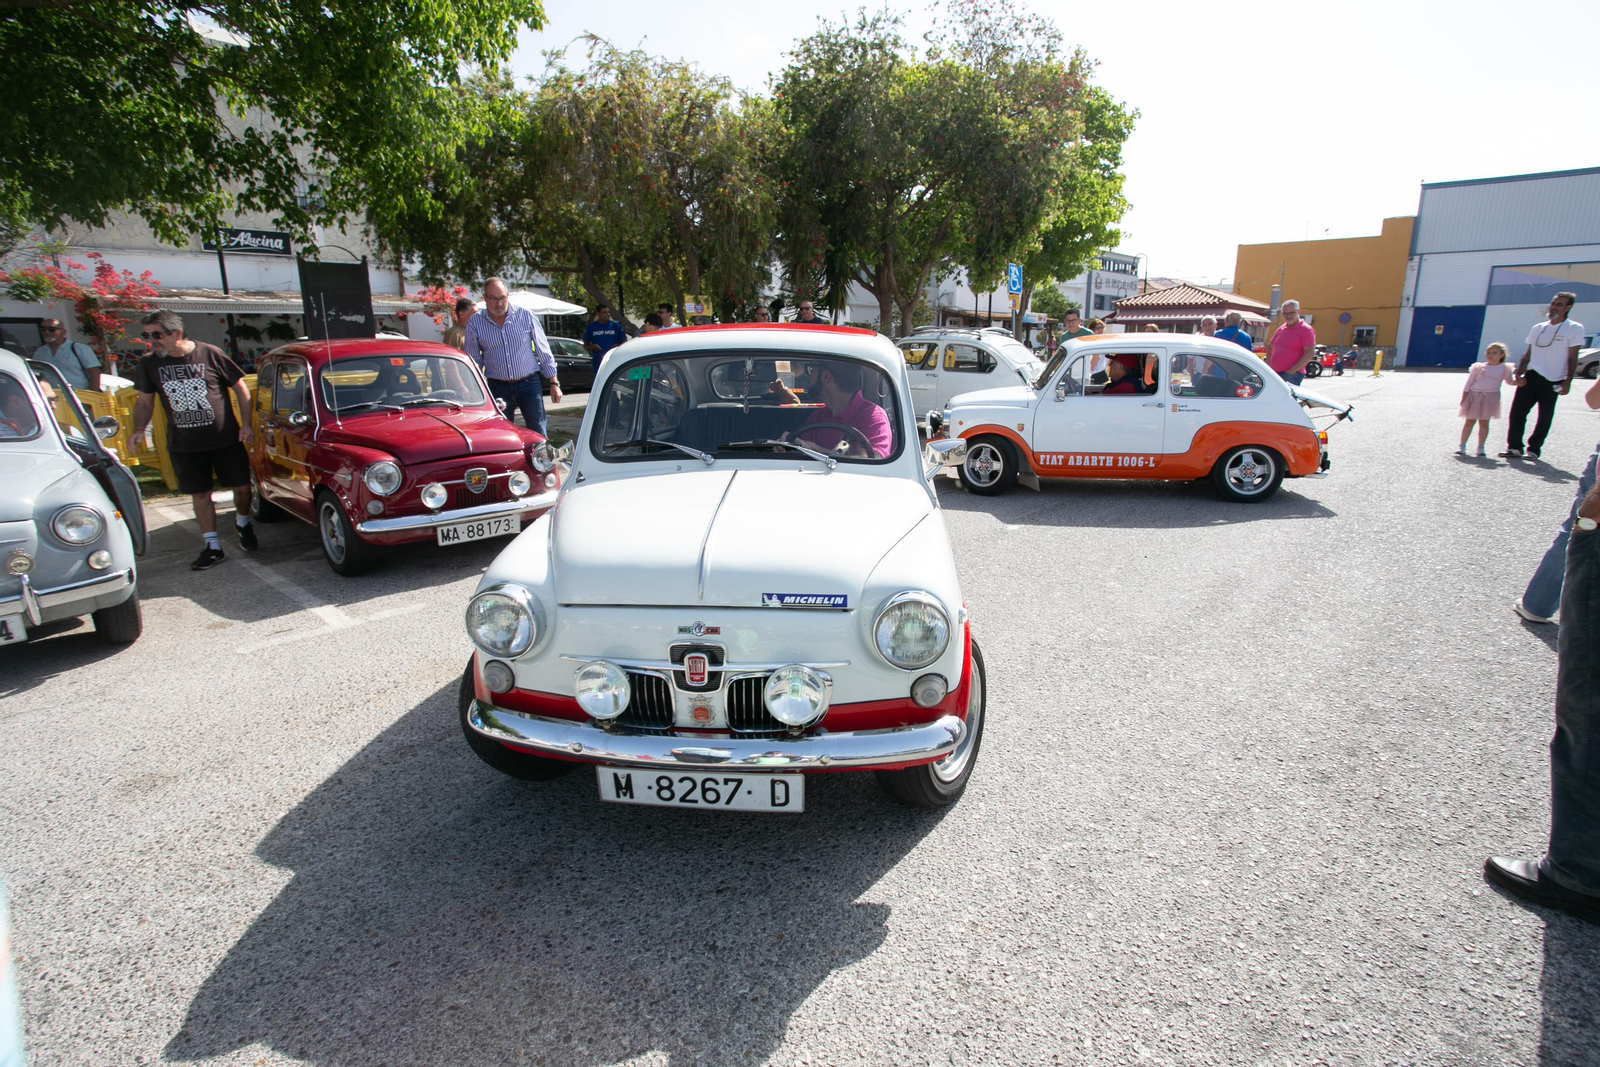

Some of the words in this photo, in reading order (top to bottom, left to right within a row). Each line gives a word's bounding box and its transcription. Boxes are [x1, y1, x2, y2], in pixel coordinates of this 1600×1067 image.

[158, 363, 205, 383] NEW
[173, 408, 215, 424] MOOD
[1040, 454, 1064, 465] FIAT
[1068, 455, 1114, 467] ABARTH
[1117, 456, 1155, 467] 1006-L
[783, 596, 844, 604] MICHELIN
[613, 772, 634, 799] M
[770, 778, 790, 807] D
